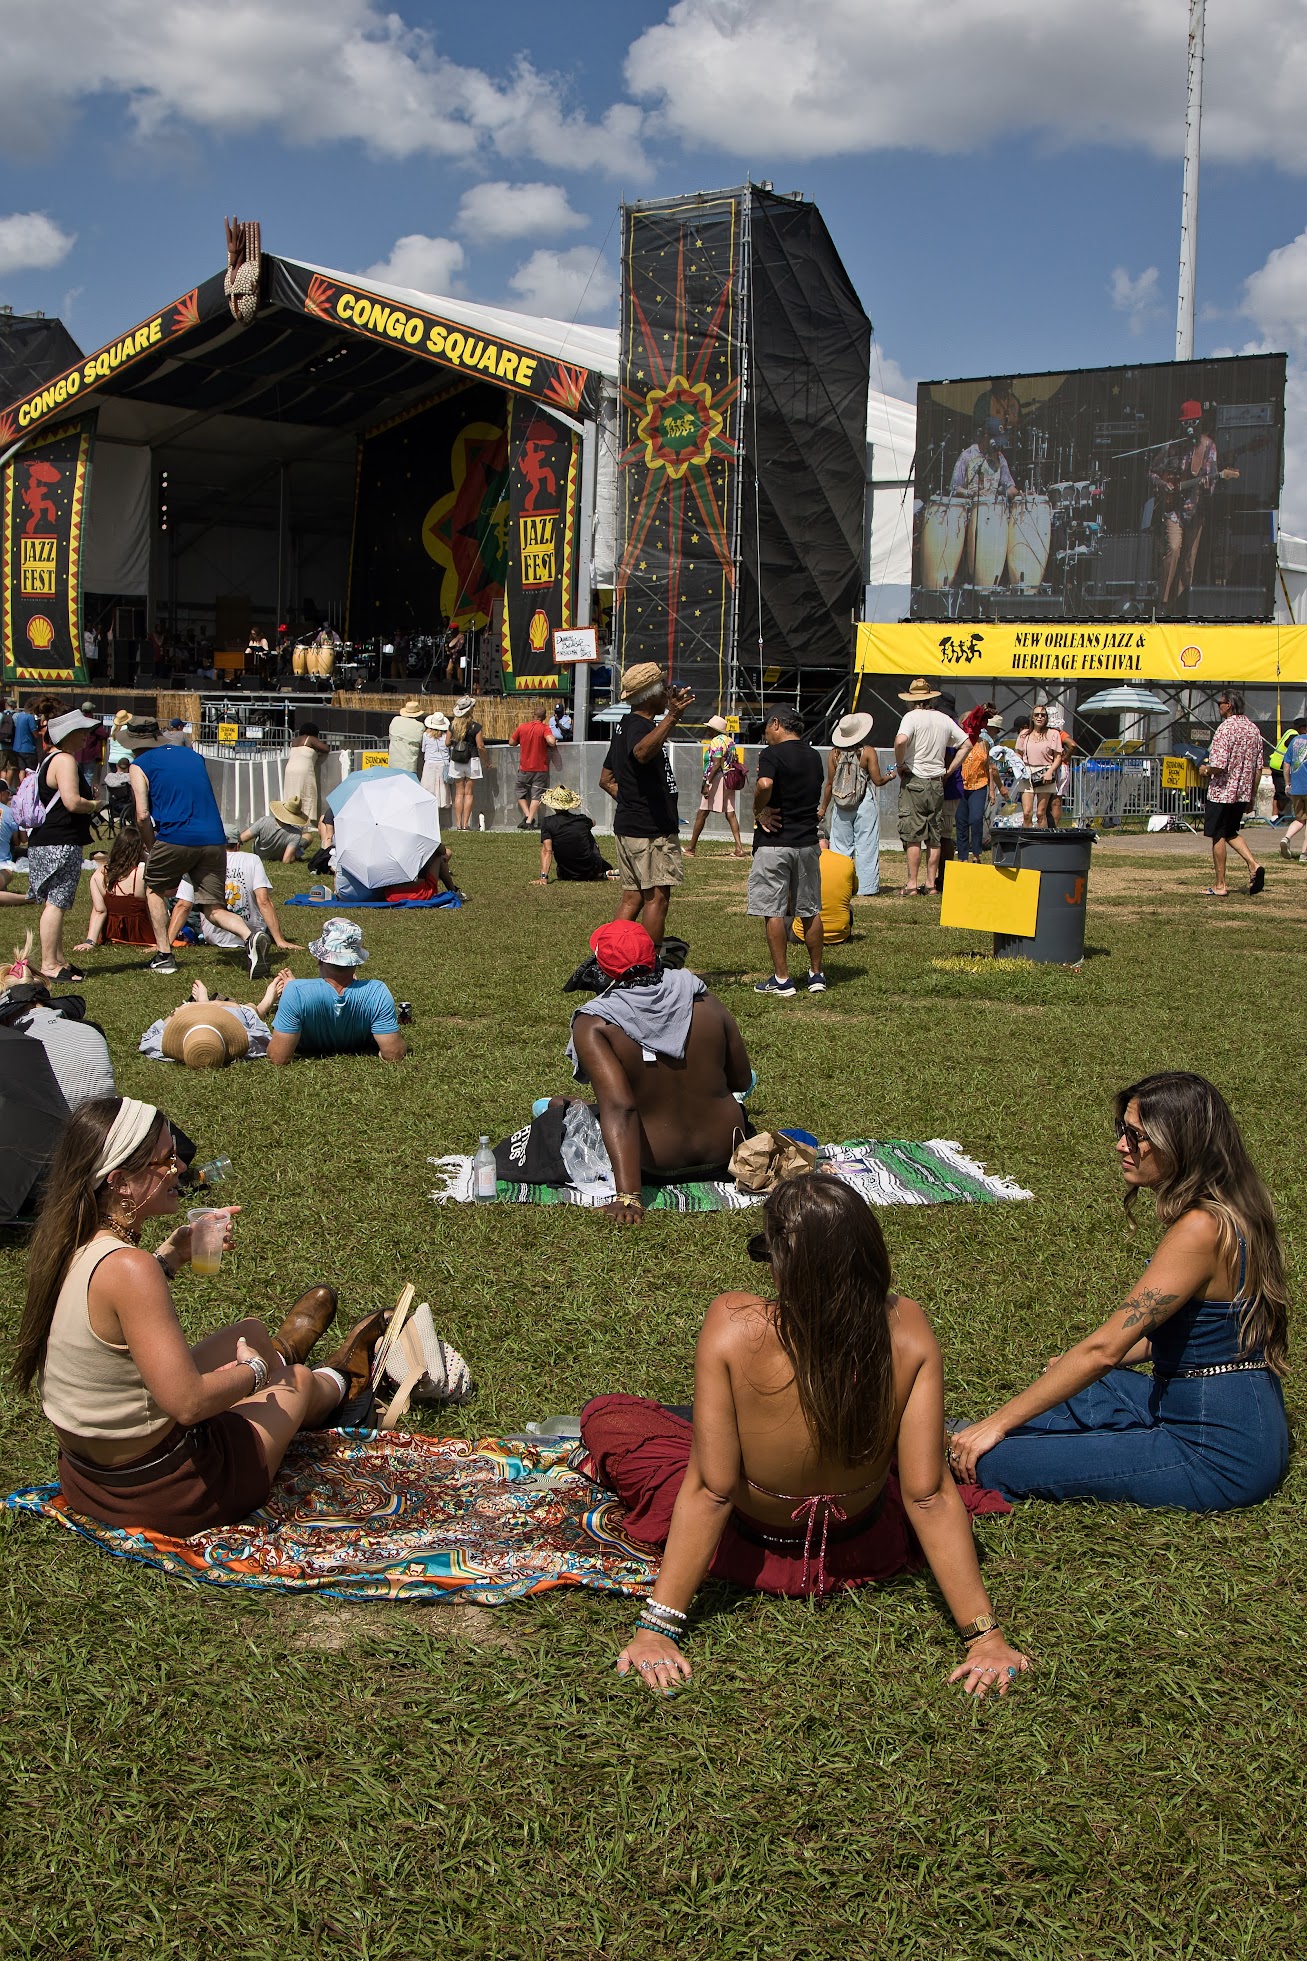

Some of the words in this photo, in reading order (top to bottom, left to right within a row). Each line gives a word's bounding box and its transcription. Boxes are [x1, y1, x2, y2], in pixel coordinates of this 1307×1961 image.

[336, 293, 425, 345] CONGO
[426, 326, 538, 387] SQUARE
[18, 371, 81, 427] CONGO
[83, 317, 163, 384] SQUARE
[522, 517, 559, 550] JAZZ
[22, 540, 55, 565] JAZZ
[523, 551, 554, 581] FEST
[22, 569, 55, 592] FEST
[1014, 632, 1042, 648] NEW
[1044, 632, 1101, 648] ORLEANS
[1101, 633, 1135, 650] JAZZ
[1136, 633, 1147, 648] &
[1012, 653, 1079, 670] HERITAGE
[1081, 654, 1143, 671] FESTIVAL
[1166, 761, 1185, 770] STANDING
